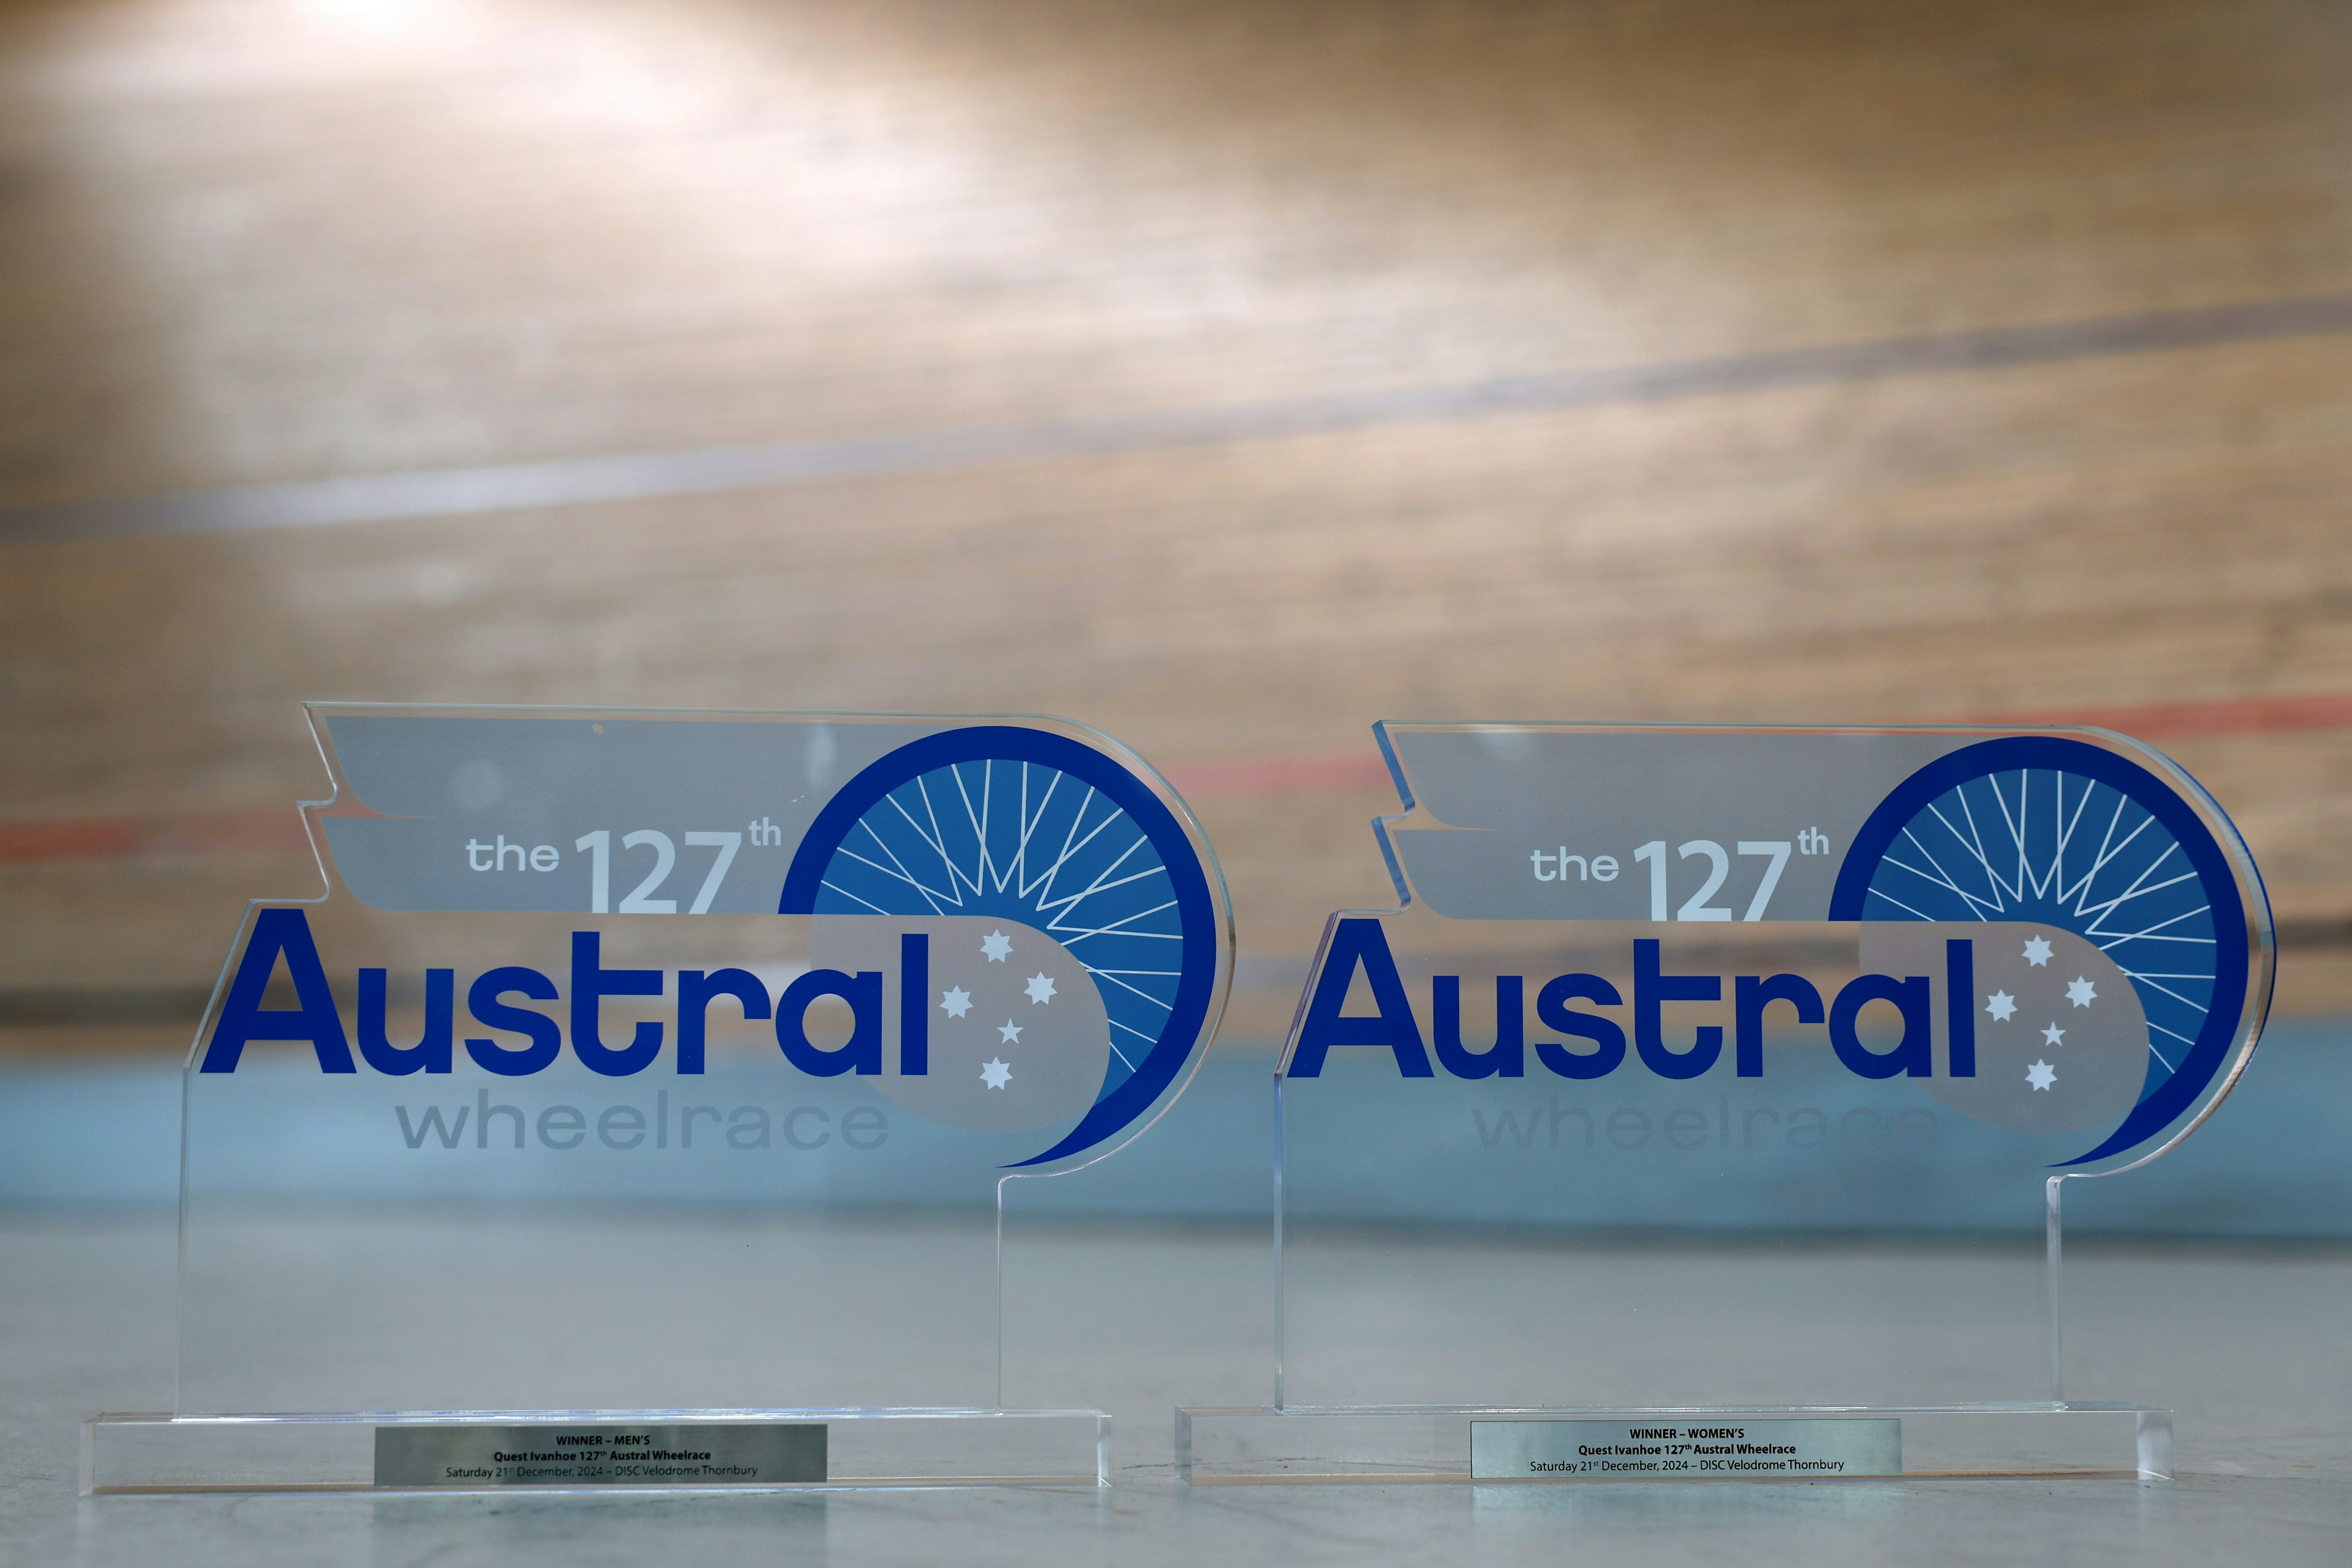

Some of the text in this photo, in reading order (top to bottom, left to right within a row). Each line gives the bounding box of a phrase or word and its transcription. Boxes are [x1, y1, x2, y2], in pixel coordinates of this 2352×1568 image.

[465, 816, 782, 915] the 127th
[1529, 826, 1830, 922] the 127th
[199, 908, 929, 1078] Austral
[1286, 918, 1976, 1080] Austral
[394, 1088, 890, 1151] wheelrace
[1470, 1093, 1942, 1152] wheelrace
[557, 1436, 602, 1446] WINNER
[1578, 1444, 1796, 1456] Quest Ivanhoe 127th Austral Wheelrace
[1629, 1429, 1677, 1439] WINNER
[446, 1467, 493, 1479] Saturday
[518, 1467, 574, 1477] December,
[577, 1467, 603, 1476] 2024
[615, 1466, 640, 1475] DISC
[643, 1466, 700, 1475] Velodrome
[702, 1465, 758, 1477] Thornbury
[494, 1450, 711, 1462] Quest Ivanhoe 127th Austral Wheelrace
[1530, 1461, 1577, 1473] Saturday
[1580, 1461, 1599, 1471] 21st
[1602, 1460, 1660, 1471] December,
[1662, 1460, 1688, 1470] 2024
[1700, 1460, 1725, 1470] DISC
[1727, 1459, 1786, 1470] Velodrome
[1787, 1459, 1844, 1471] Thornbury
